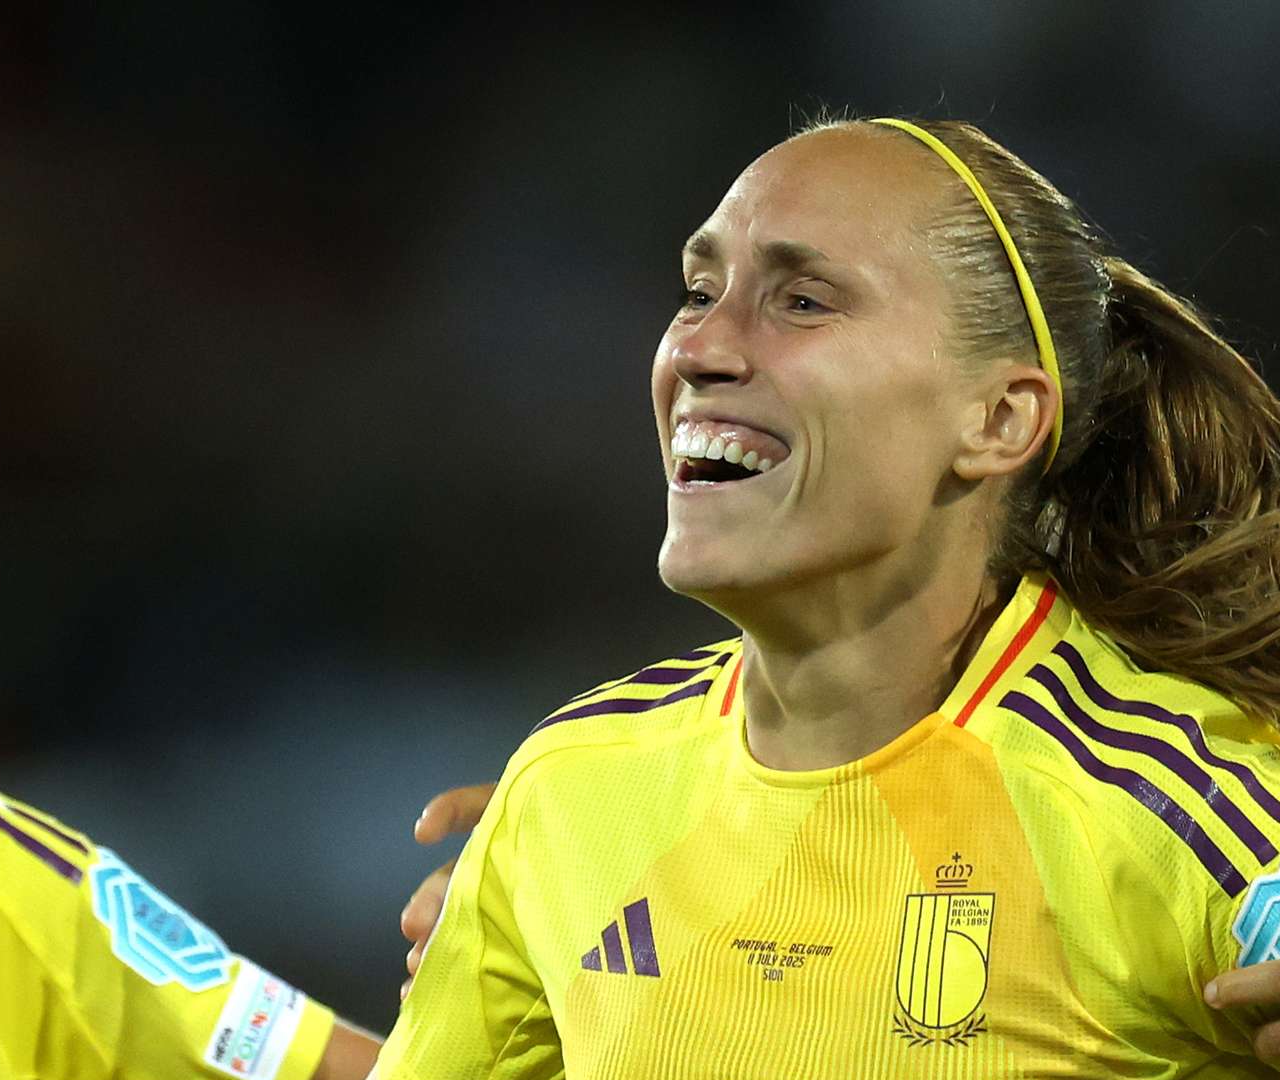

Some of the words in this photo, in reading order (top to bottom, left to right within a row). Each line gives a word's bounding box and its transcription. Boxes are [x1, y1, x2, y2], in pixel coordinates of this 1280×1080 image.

[952, 898, 980, 908] ROYAL
[951, 908, 990, 917] BELGIAN
[730, 938, 778, 952] PORTUGAL
[789, 943, 833, 957] BELGIUM
[756, 953, 779, 966] JULY
[780, 956, 806, 968] 2025
